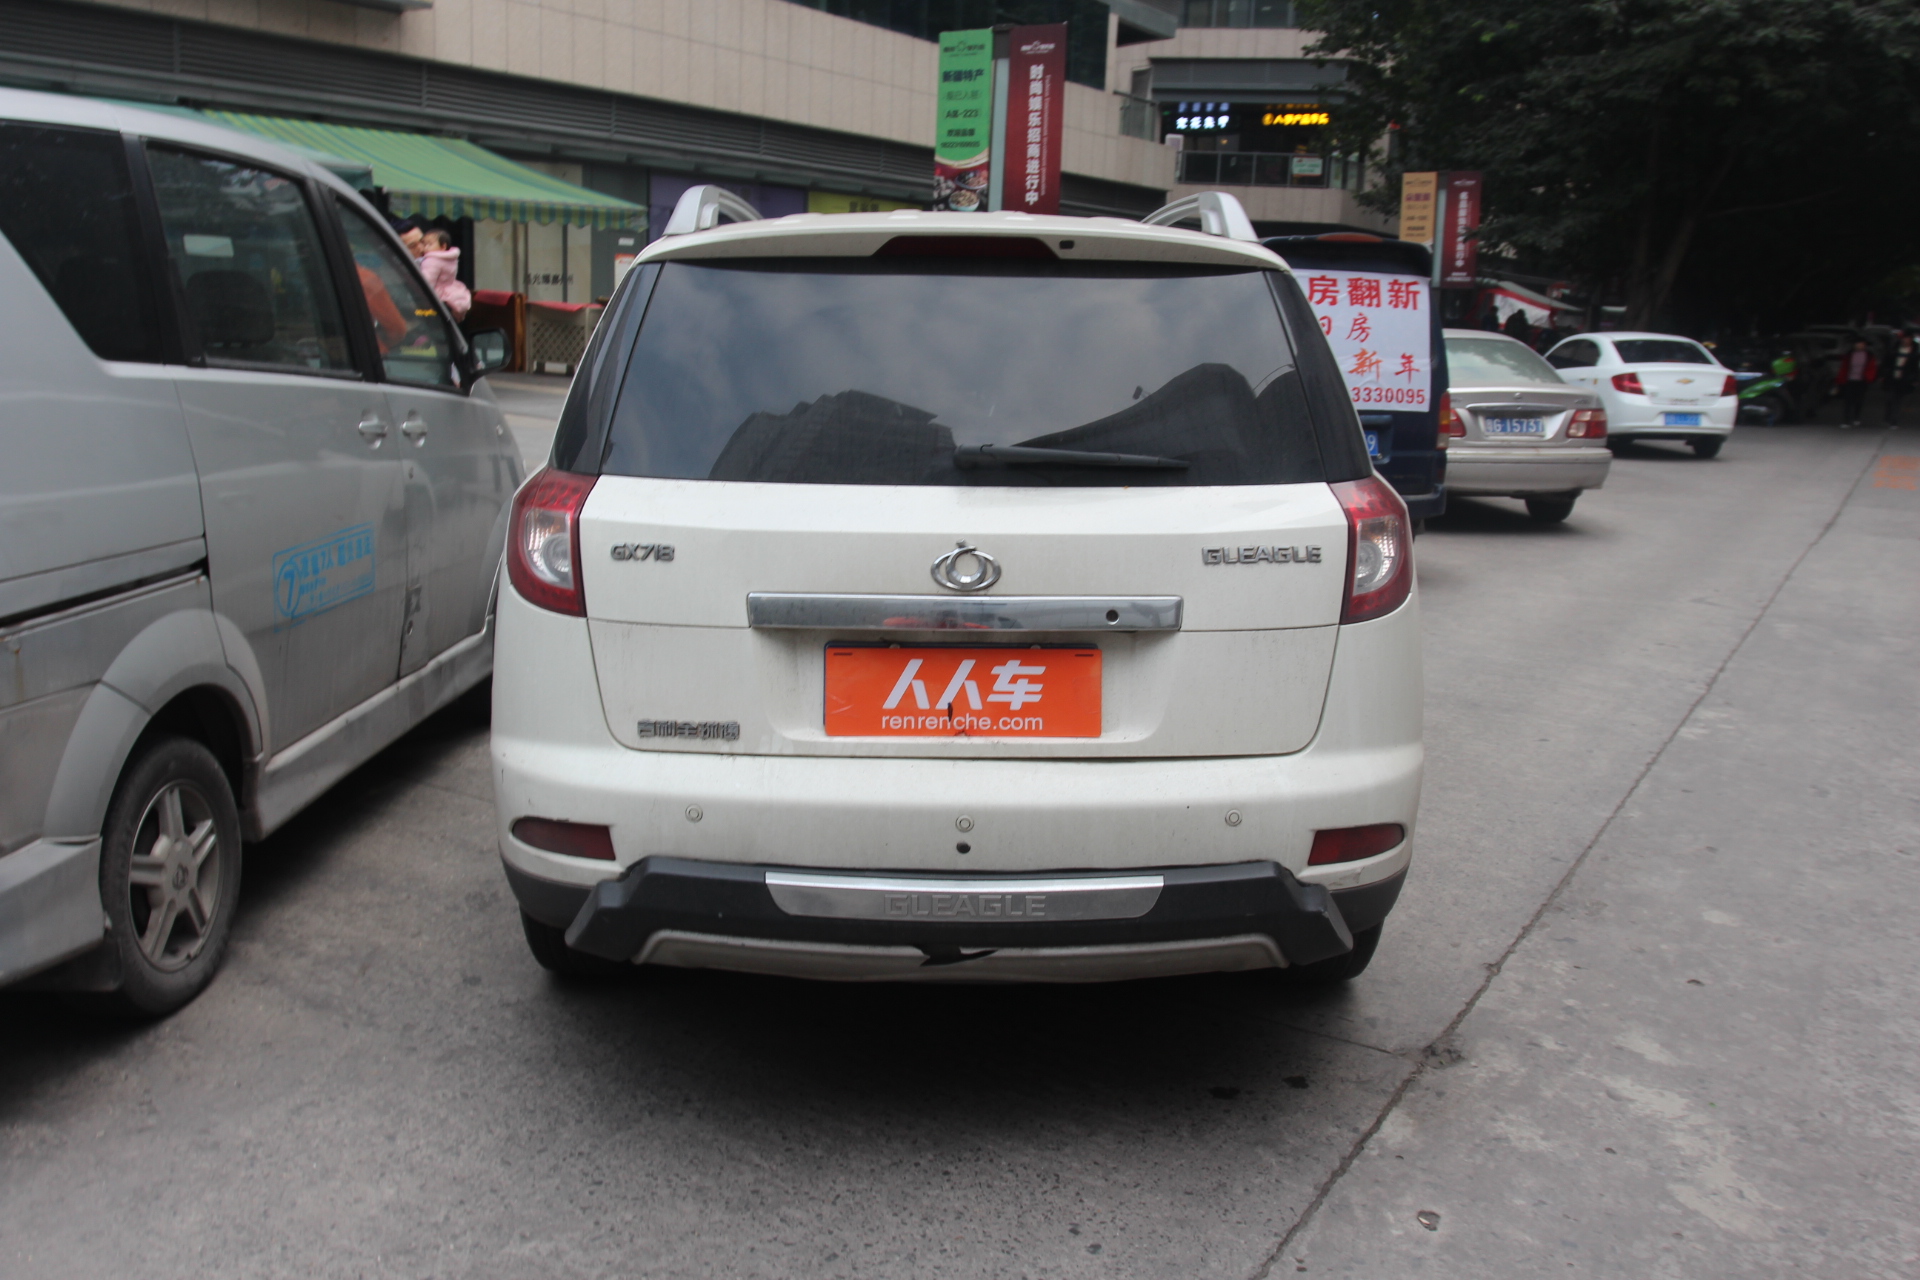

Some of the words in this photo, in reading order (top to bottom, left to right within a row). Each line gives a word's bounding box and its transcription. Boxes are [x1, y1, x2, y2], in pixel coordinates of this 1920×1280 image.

[1307, 275, 1421, 310] 房翻新
[1351, 386, 1425, 404] 3330095
[1202, 544, 1322, 565] GLEAGLE
[882, 658, 1046, 711] 人人车
[881, 713, 1043, 731] renrenche.com
[884, 893, 1046, 917] GLEAGLE
